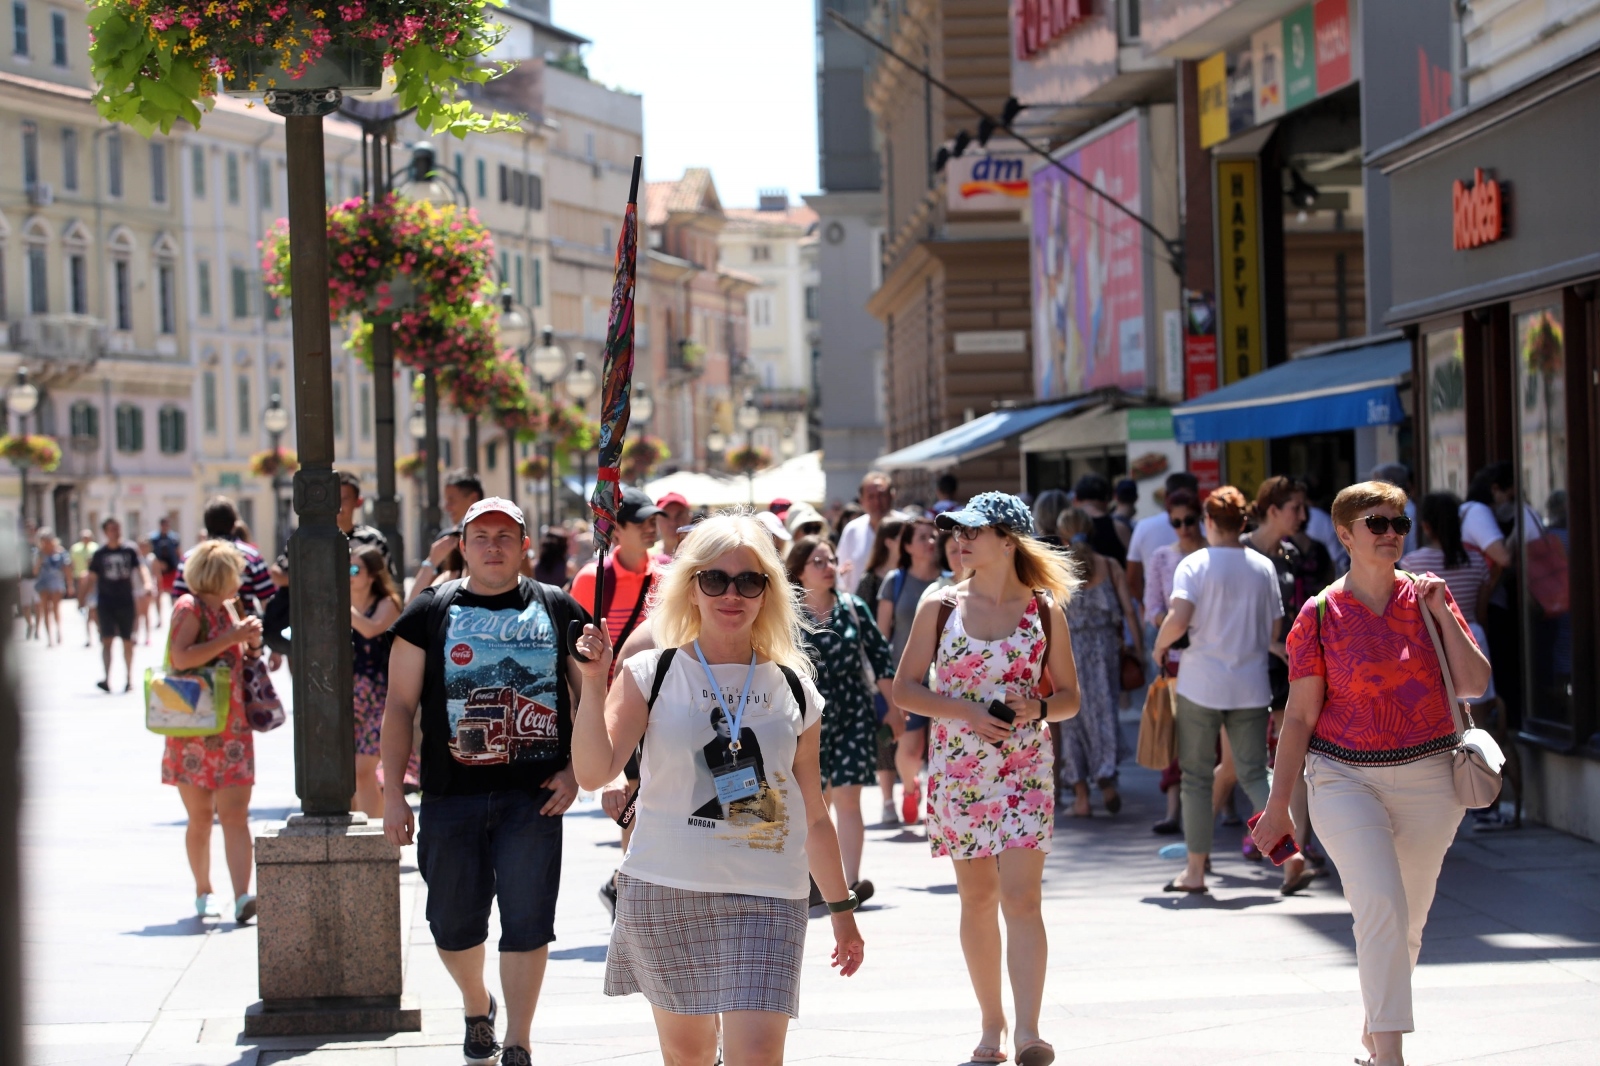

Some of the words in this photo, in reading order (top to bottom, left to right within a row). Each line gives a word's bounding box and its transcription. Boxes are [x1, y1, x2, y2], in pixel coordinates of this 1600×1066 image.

[972, 153, 1023, 181] dm
[1231, 173, 1247, 309] HAPPY
[687, 817, 716, 829] MORGAN
